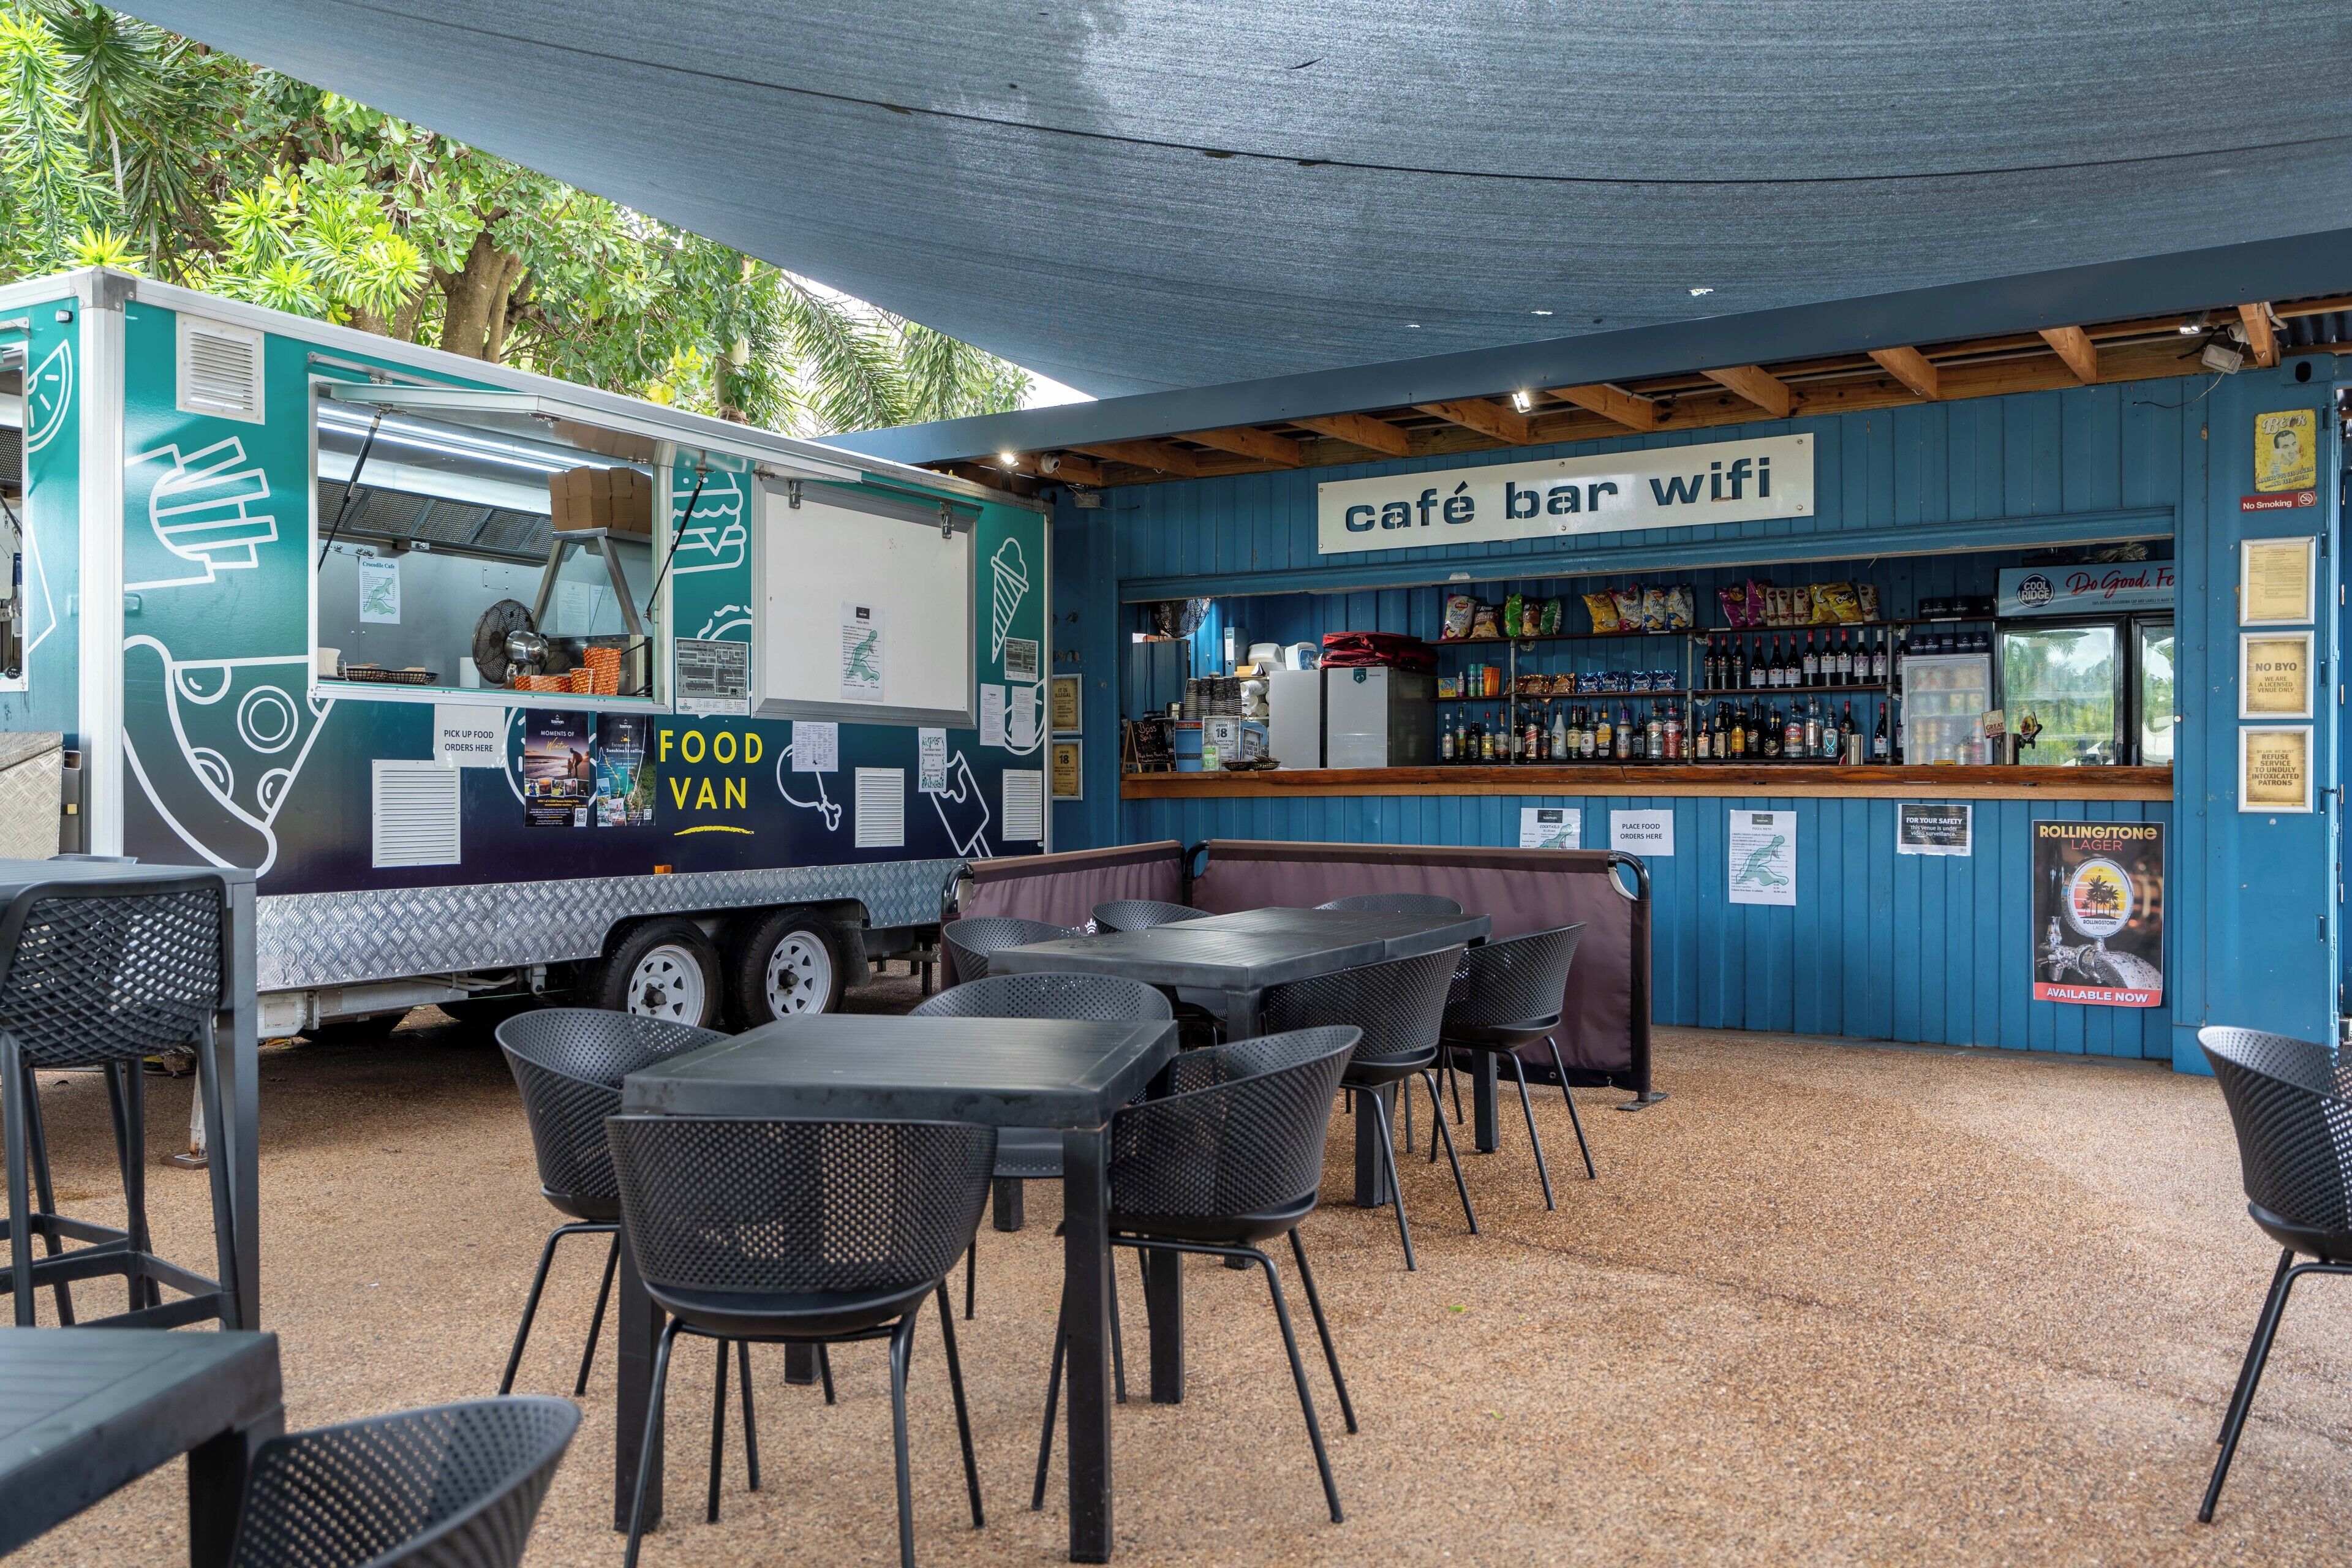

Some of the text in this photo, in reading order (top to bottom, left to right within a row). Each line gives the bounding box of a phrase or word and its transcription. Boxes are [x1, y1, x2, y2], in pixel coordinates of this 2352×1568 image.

[1345, 457, 1770, 532] café bar wifi
[2024, 581, 2048, 591] COOL
[2066, 572, 2097, 596] Do
[2021, 590, 2050, 600] RIDGE
[2255, 662, 2297, 671] NO BYO
[1137, 722, 1157, 734] Boss
[1216, 728, 1227, 738] 18
[546, 737, 570, 752] Winter
[660, 730, 763, 764] FOOD
[1059, 755, 1069, 764] 18
[669, 777, 746, 810] VAN
[2071, 839, 2122, 851] LAGER
[2047, 987, 2149, 1003] AVAILABLE NOW
